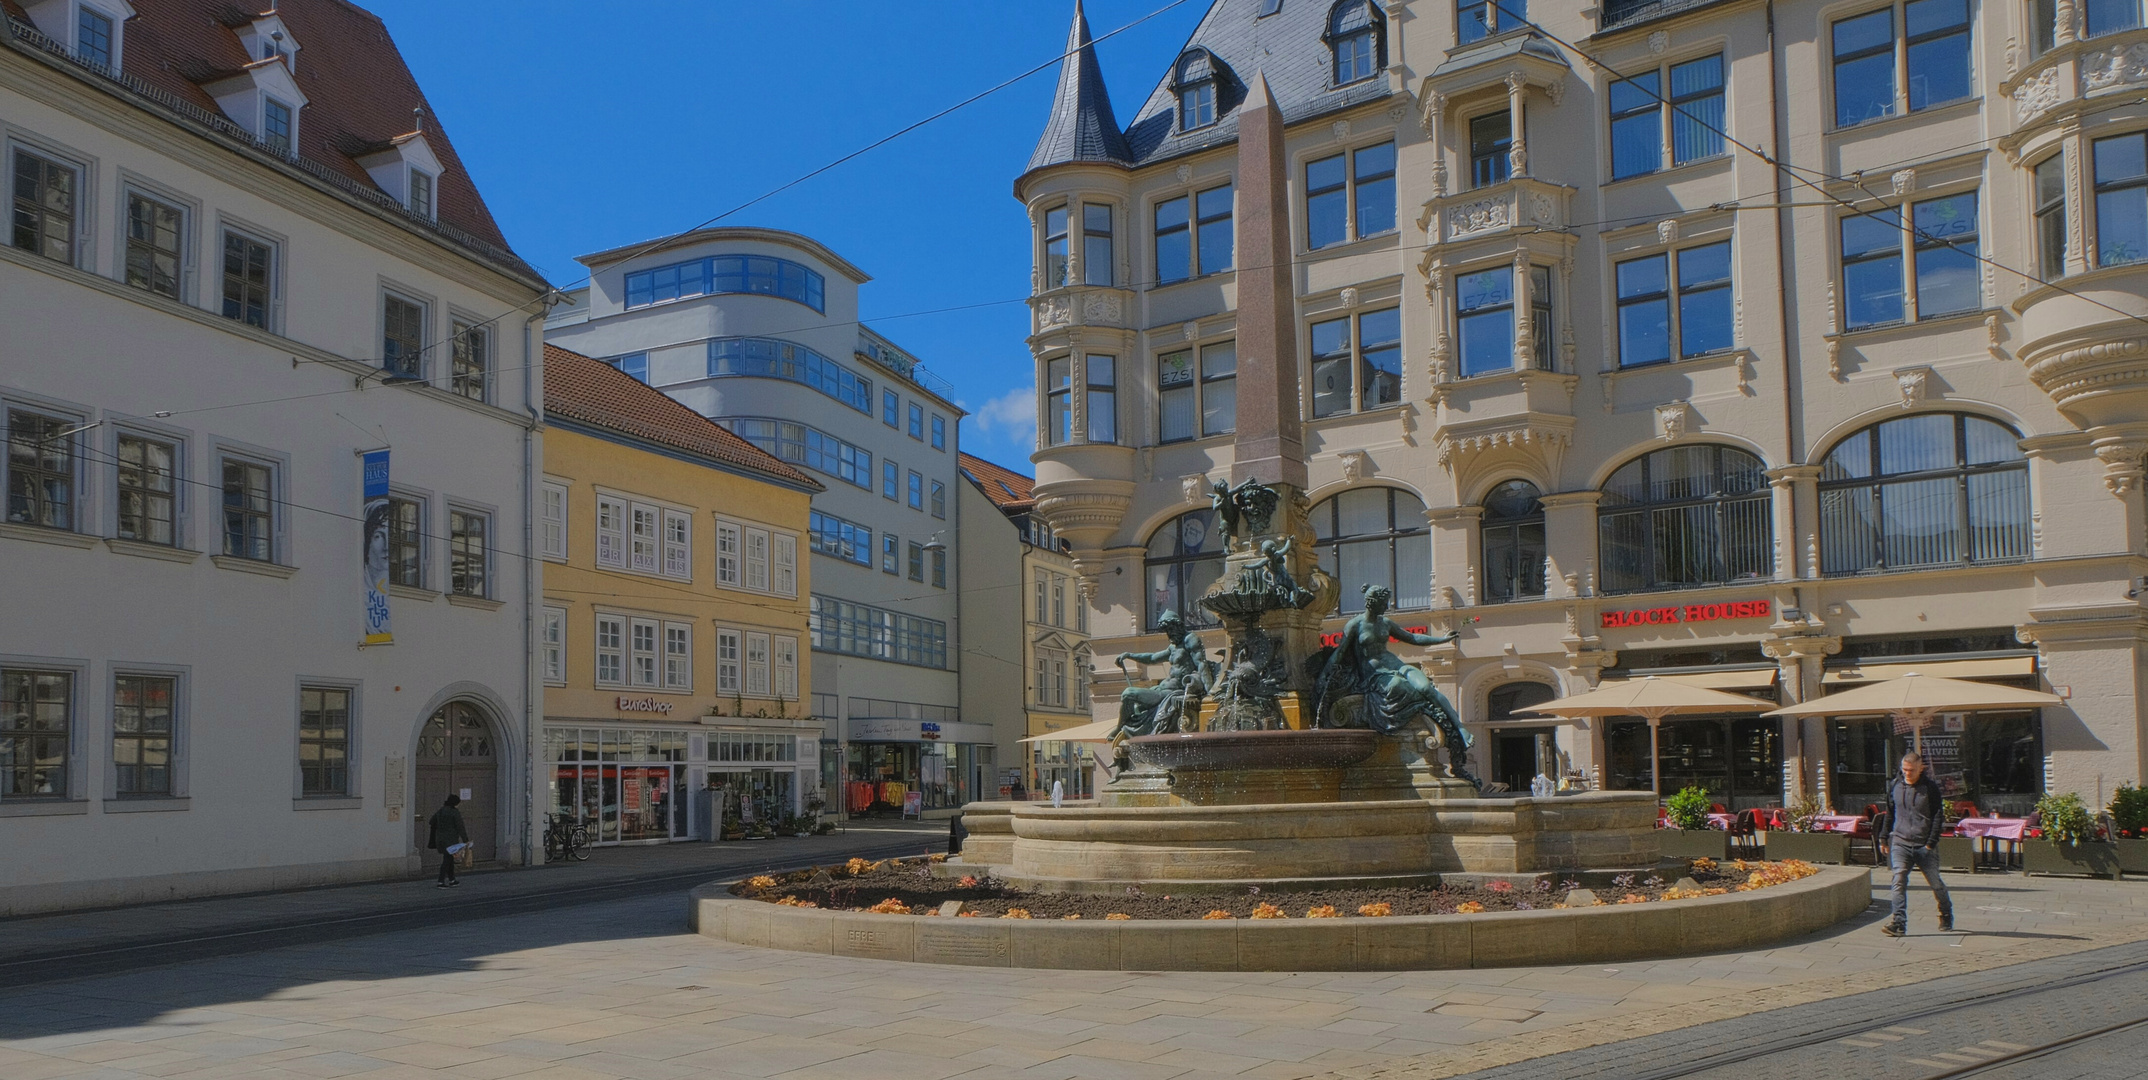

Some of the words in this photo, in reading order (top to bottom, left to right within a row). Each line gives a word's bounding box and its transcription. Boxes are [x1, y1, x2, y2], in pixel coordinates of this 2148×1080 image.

[1464, 289, 1509, 308] EZSI
[1161, 368, 1194, 384] EZSI
[1601, 607, 1680, 628] BLOCK
[1684, 600, 1771, 622] HOUSE
[848, 930, 874, 942] EFRE
